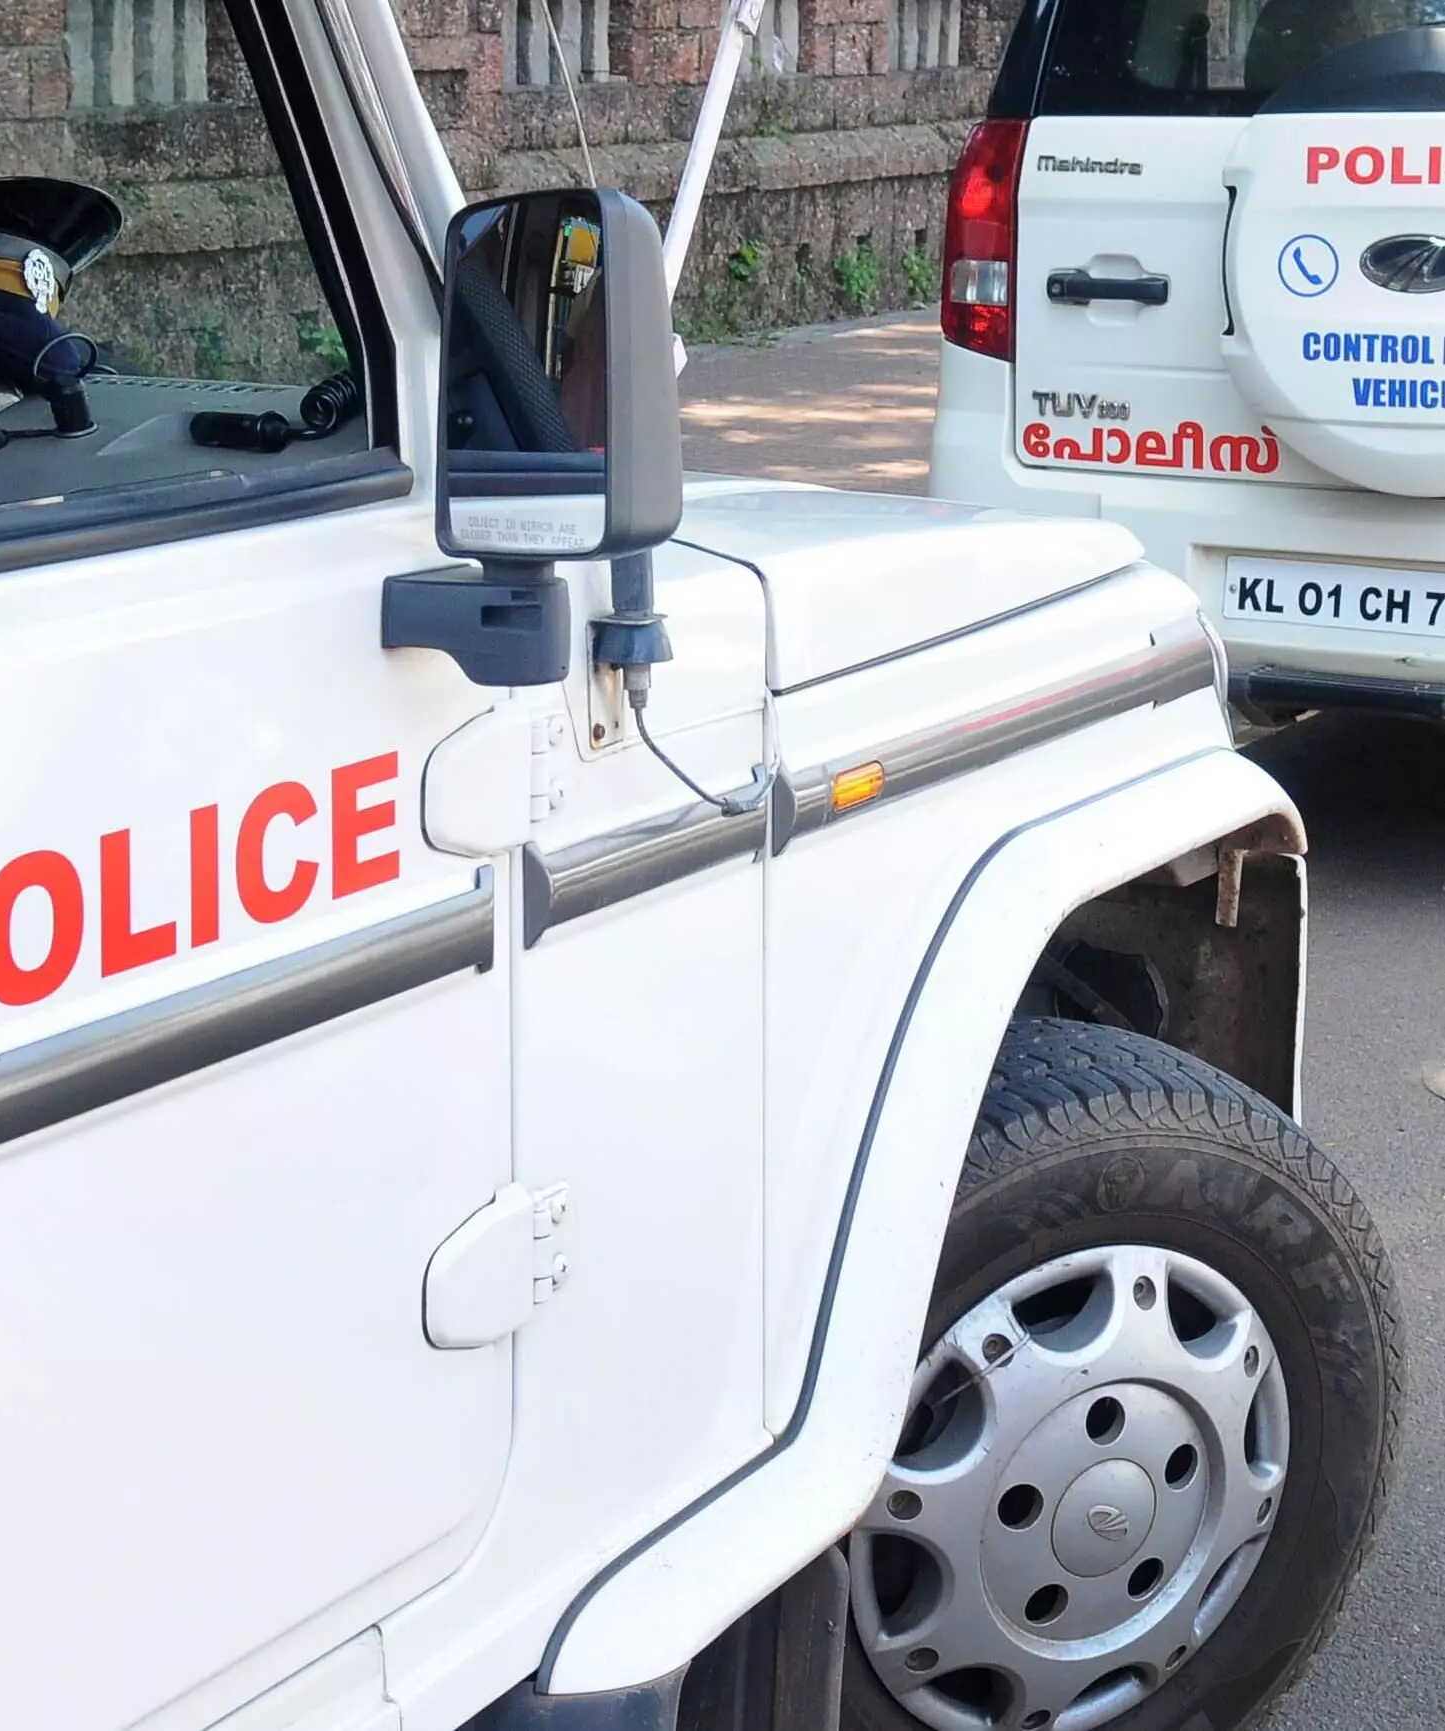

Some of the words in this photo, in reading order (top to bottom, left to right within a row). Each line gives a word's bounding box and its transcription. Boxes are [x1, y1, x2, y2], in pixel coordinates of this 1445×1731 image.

[1037, 155, 1143, 176] Mahindra
[1306, 146, 1445, 185] POLI
[1301, 331, 1435, 366] CONTROL
[1023, 420, 1280, 474] പോലീസ്
[497, 529, 519, 544] THAN
[523, 532, 546, 546] THEY
[505, 517, 517, 531] IN
[1237, 576, 1284, 614] KL
[1359, 586, 1412, 625] CH
